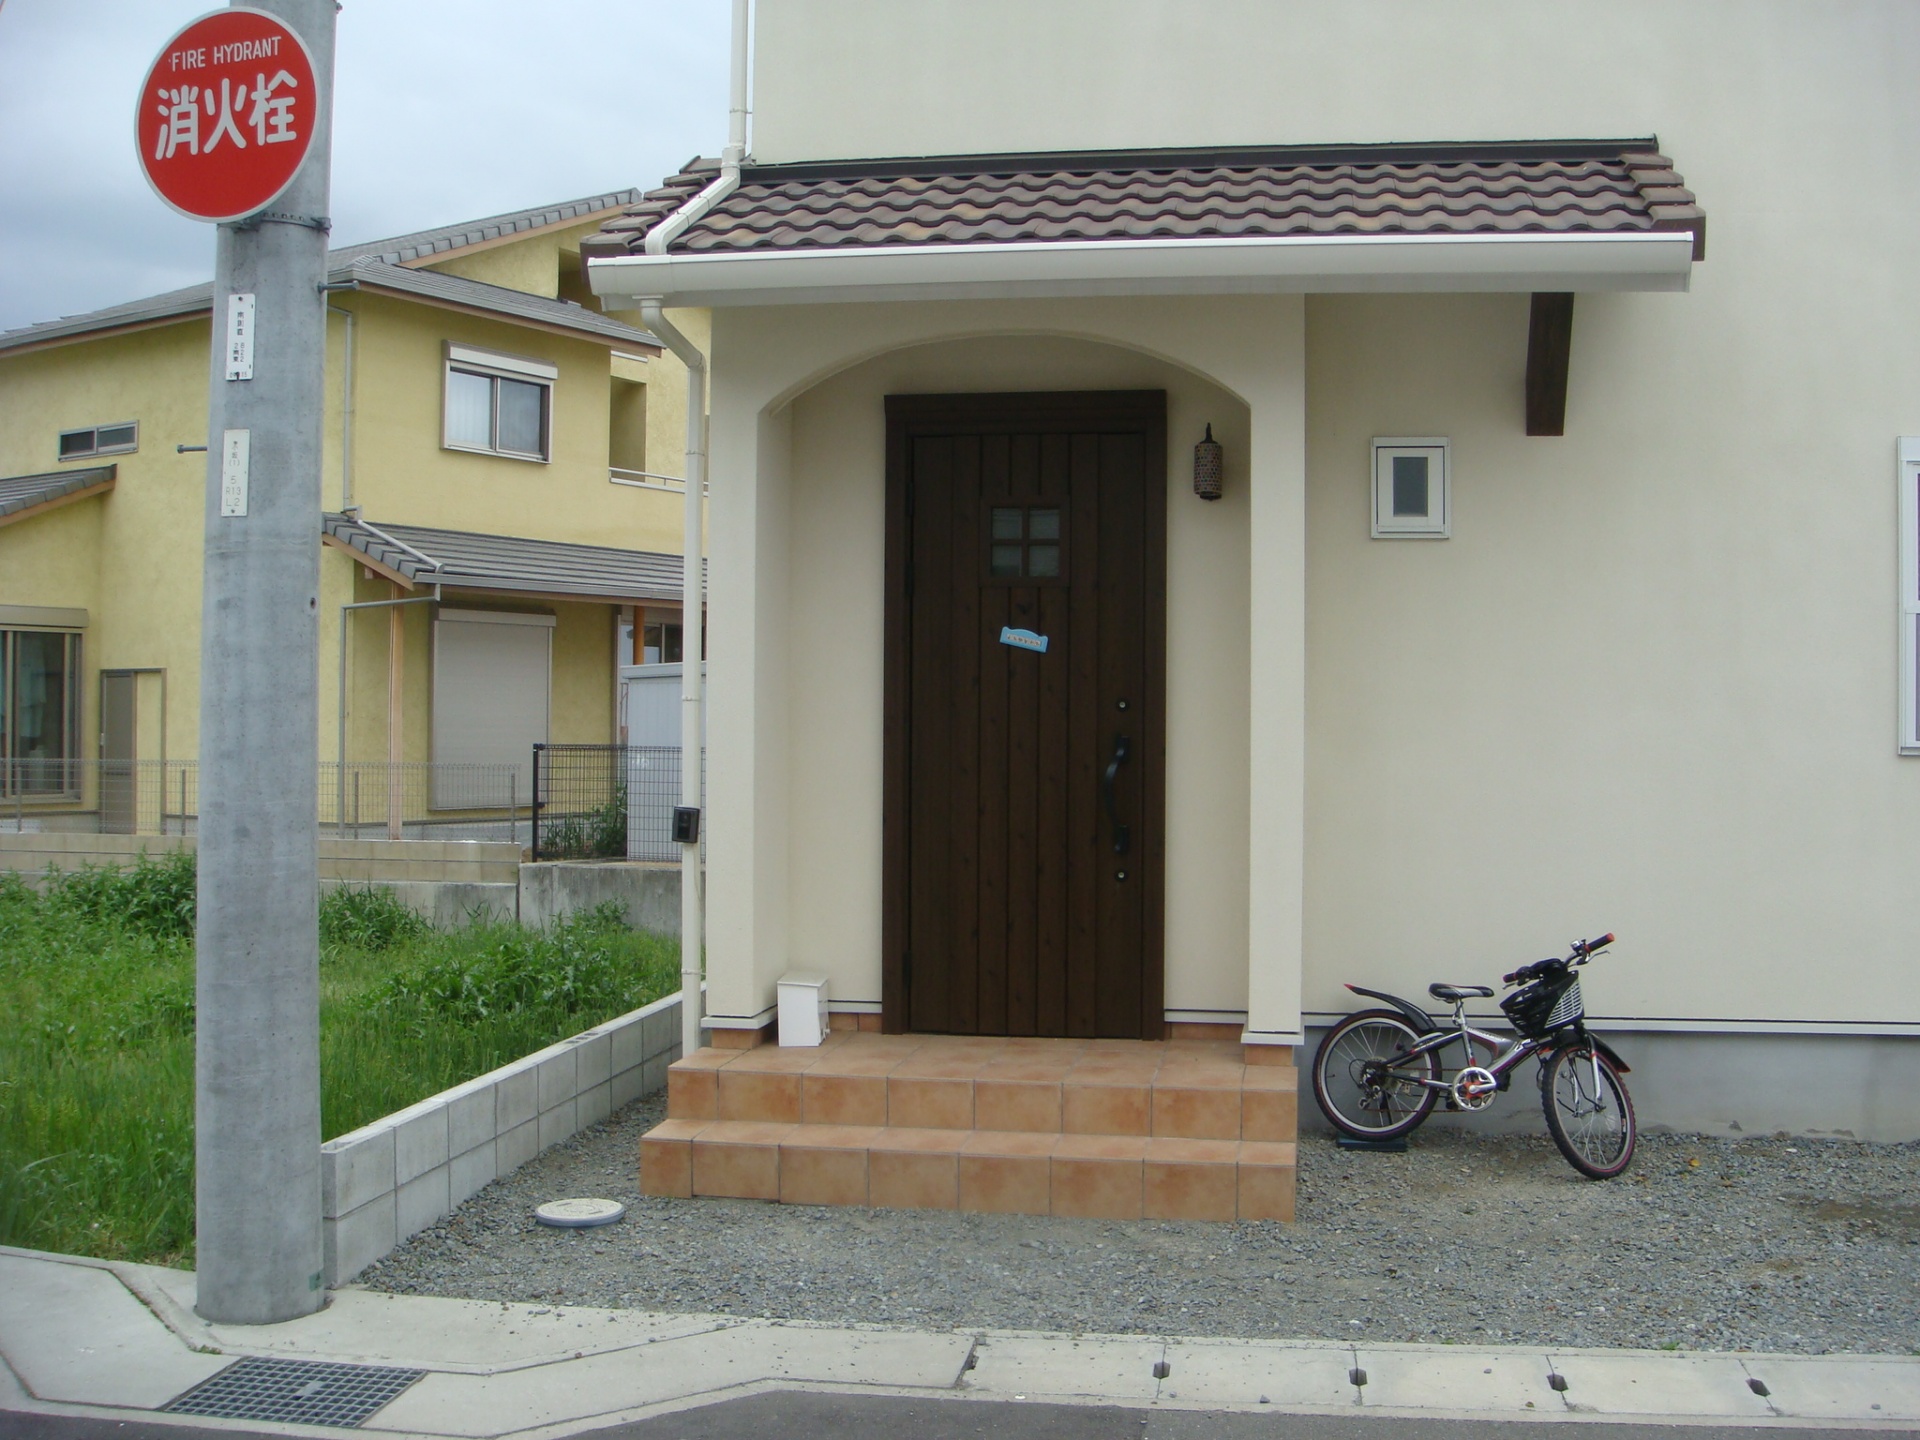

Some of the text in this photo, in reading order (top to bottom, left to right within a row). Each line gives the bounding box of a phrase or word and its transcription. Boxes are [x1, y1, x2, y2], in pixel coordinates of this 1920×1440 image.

[172, 36, 282, 72] FIRE HYDRANT
[155, 69, 298, 160] 消火栓
